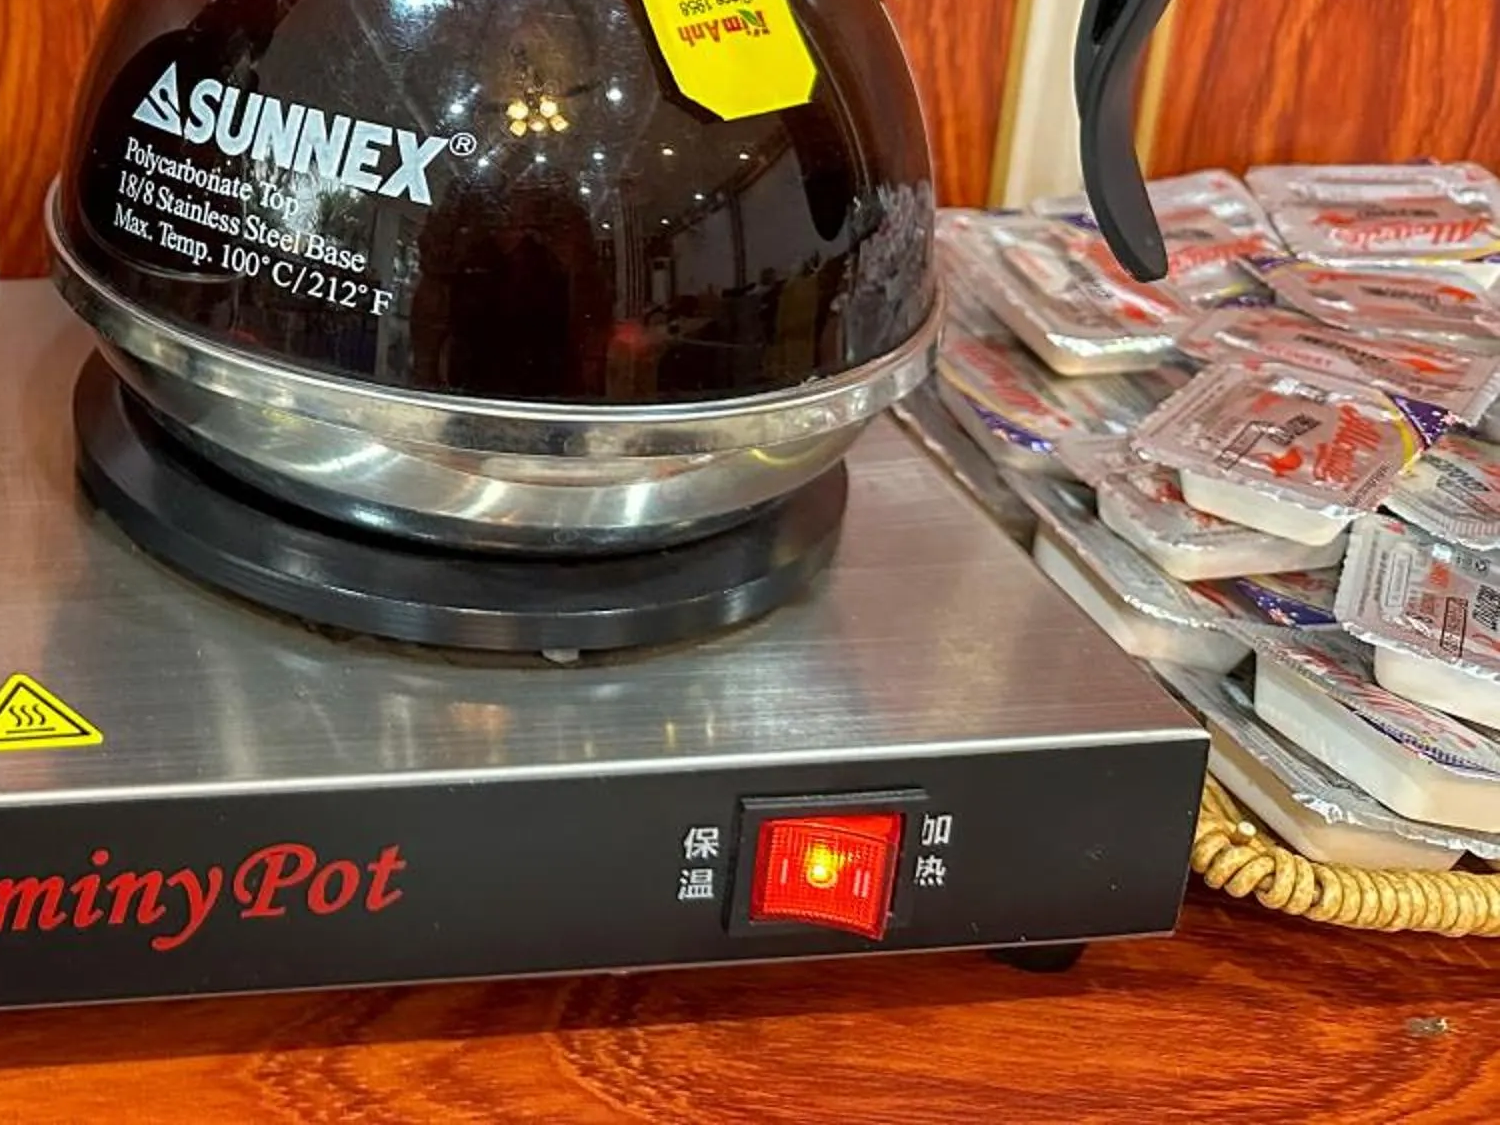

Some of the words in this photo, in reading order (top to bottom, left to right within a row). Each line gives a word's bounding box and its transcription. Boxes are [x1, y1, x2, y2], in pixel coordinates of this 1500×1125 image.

[124, 136, 251, 201] Polycarbonate
[260, 180, 299, 219] Top
[113, 203, 153, 241] Max.
[158, 221, 213, 265] Temp.
[117, 170, 155, 206] 18/8
[155, 187, 241, 237] Stainless
[243, 215, 300, 255] Steel
[304, 233, 367, 273] Base
[677, 826, 721, 901] 保温
[914, 813, 953, 887] 加热
